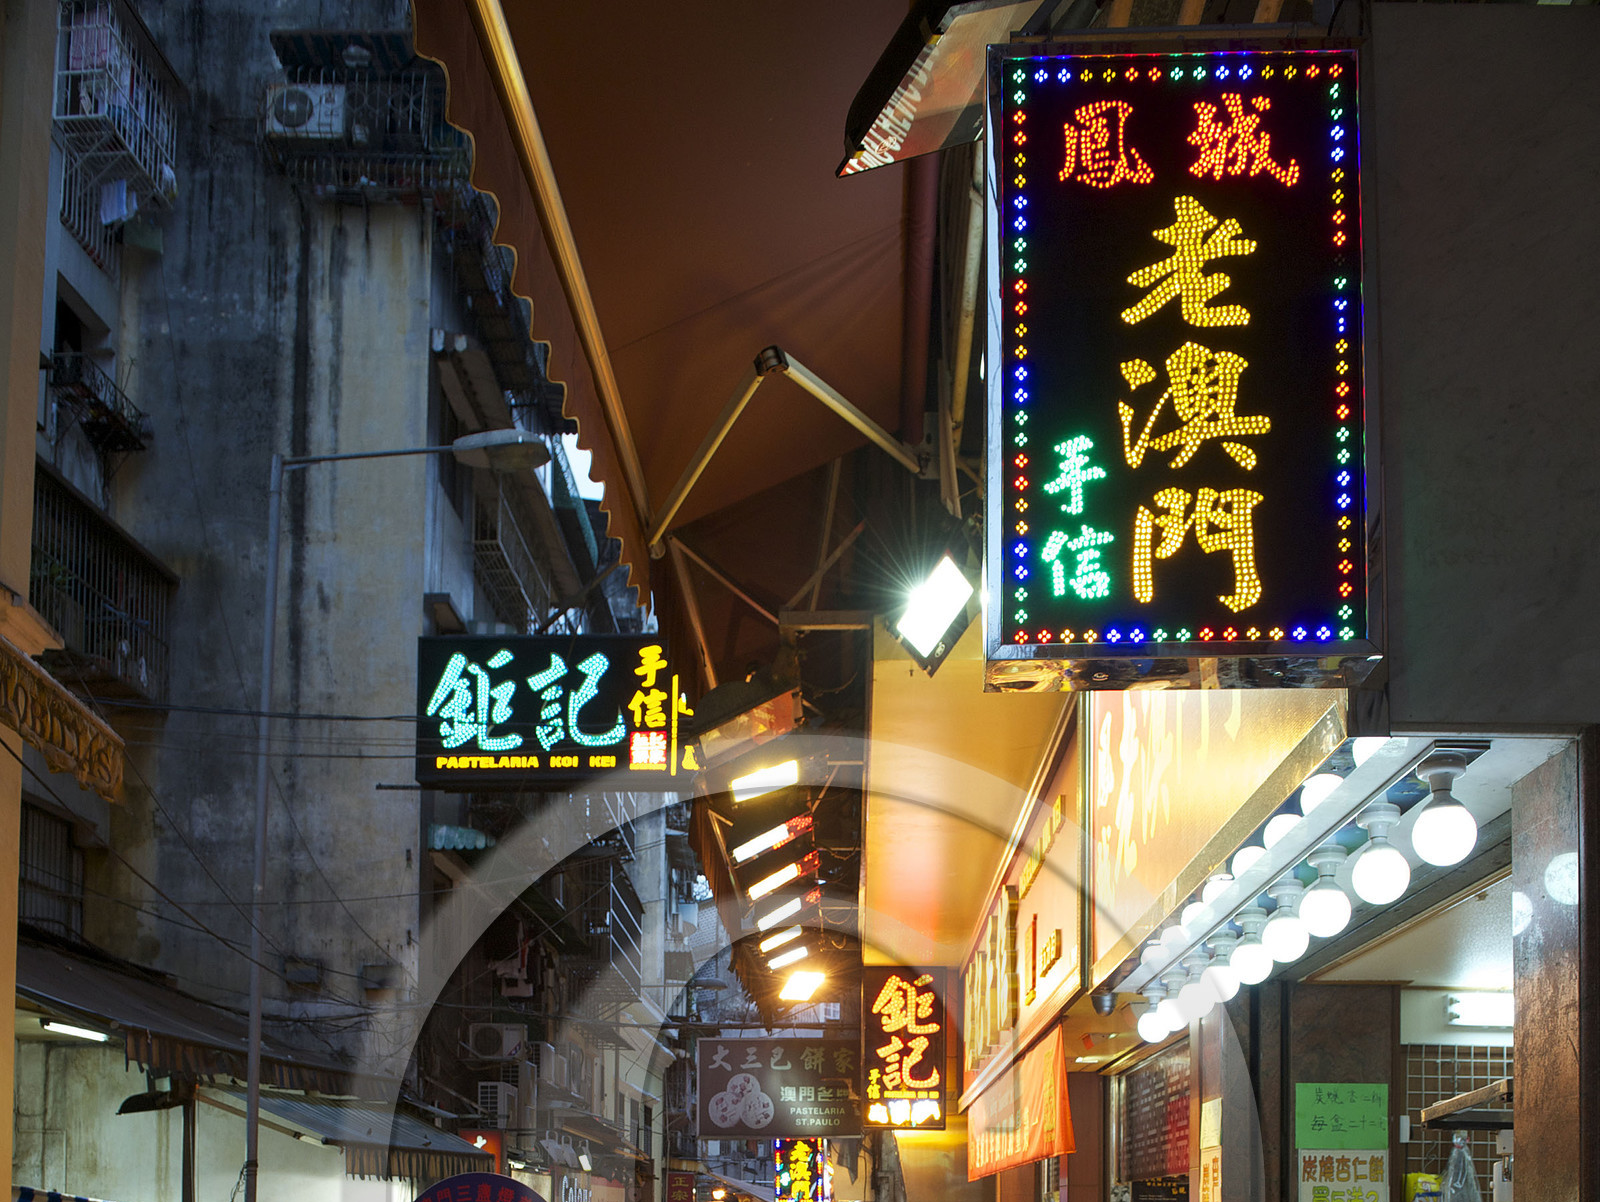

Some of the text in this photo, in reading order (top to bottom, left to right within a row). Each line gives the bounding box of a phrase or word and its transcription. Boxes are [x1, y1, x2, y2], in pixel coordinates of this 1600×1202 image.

[1058, 93, 1300, 188] 鳳城
[1120, 195, 1271, 613] 老澳門
[1042, 434, 1114, 600] 手信
[426, 648, 627, 751] 鉅記
[627, 644, 668, 728] 手信
[436, 756, 616, 769] PASTELARIA KOI KEI
[708, 1044, 856, 1074] 大三巴餅家
[872, 974, 940, 1090] 鉅記
[790, 1106, 846, 1116] PASTELARIA
[795, 1118, 841, 1127] ST.PAULO
[790, 1141, 812, 1199] 老澳門
[1302, 1155, 1385, 1182] 炭燒杏仁餅
